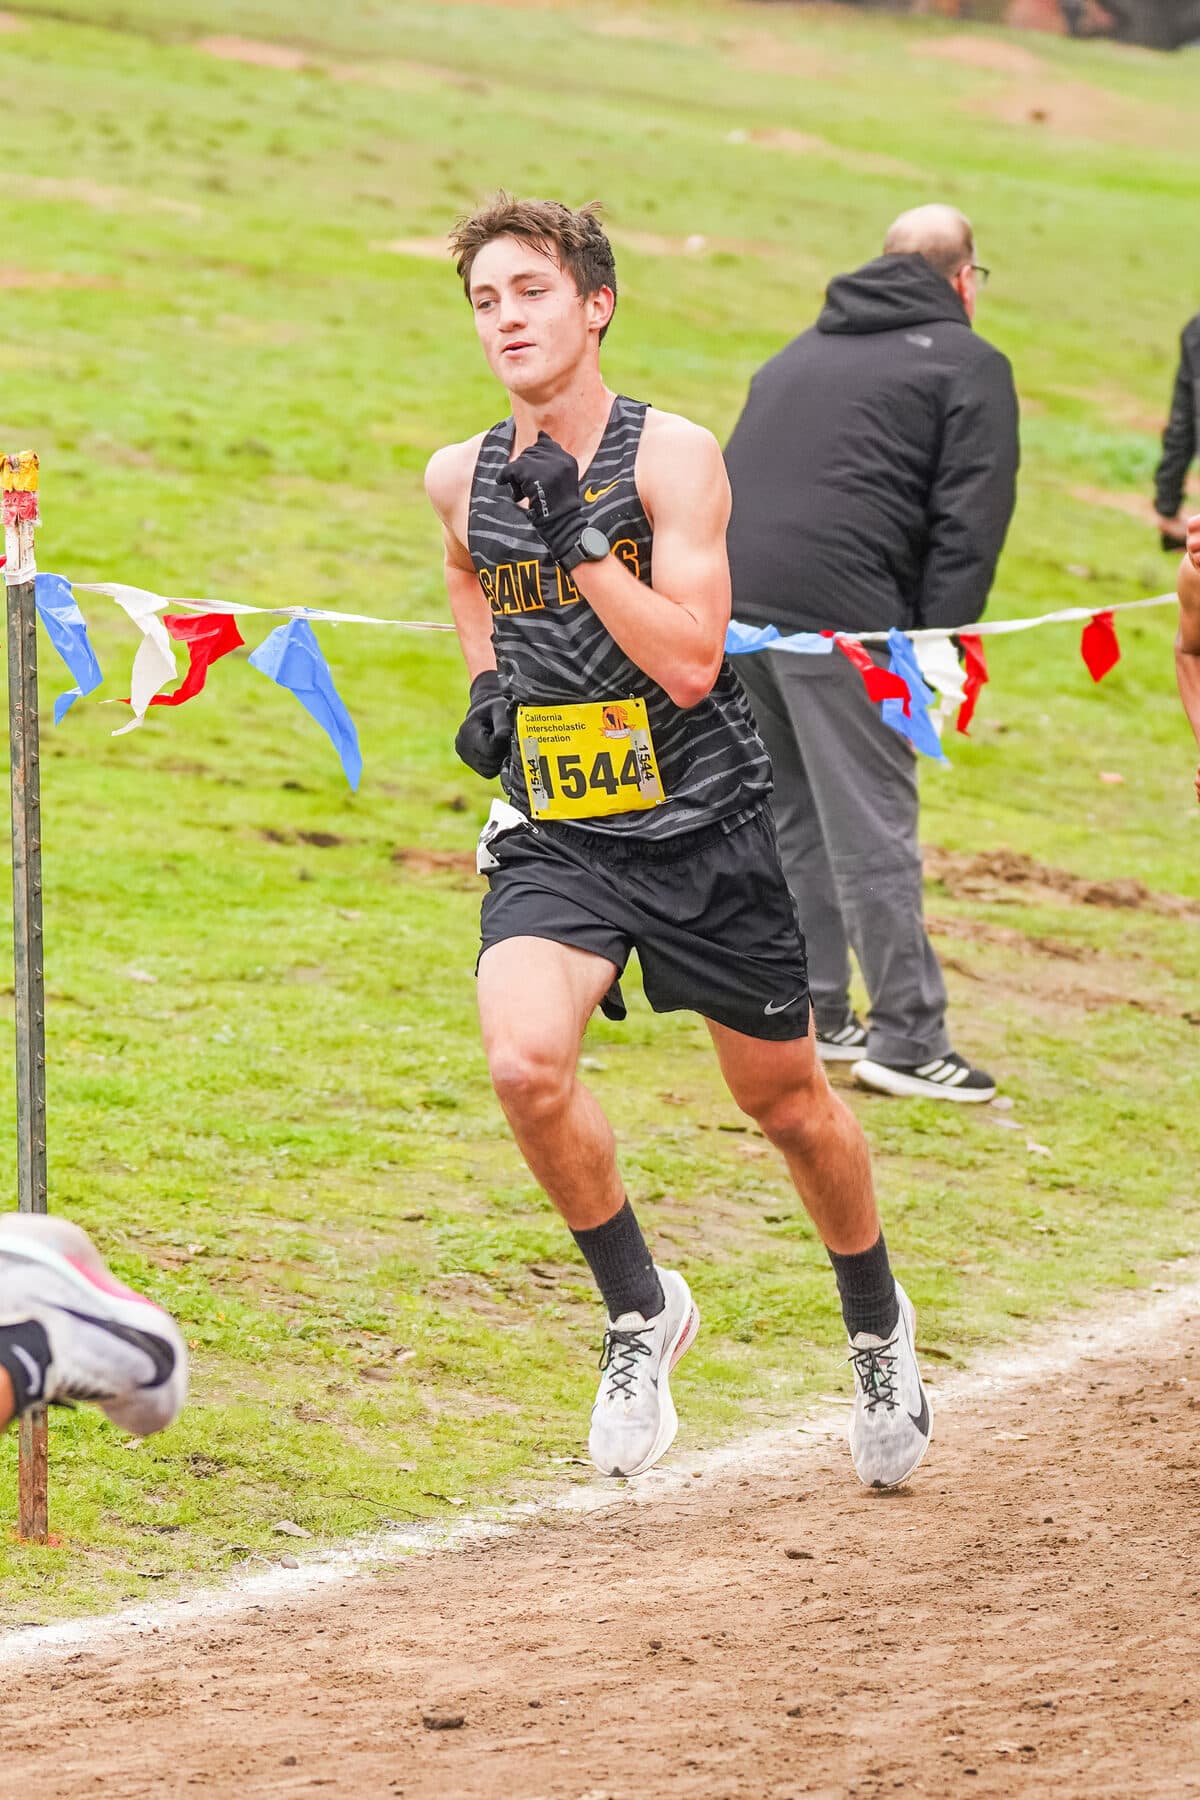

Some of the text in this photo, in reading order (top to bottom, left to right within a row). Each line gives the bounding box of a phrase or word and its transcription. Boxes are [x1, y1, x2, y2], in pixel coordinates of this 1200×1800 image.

[534, 480, 550, 518] HEAD
[479, 538, 640, 616] SAN LS
[525, 713, 563, 723] California
[526, 722, 587, 733] Interscholastic
[528, 734, 571, 744] deration
[528, 758, 541, 795] 1544
[539, 749, 642, 801] 1544
[639, 744, 655, 782] 1544
